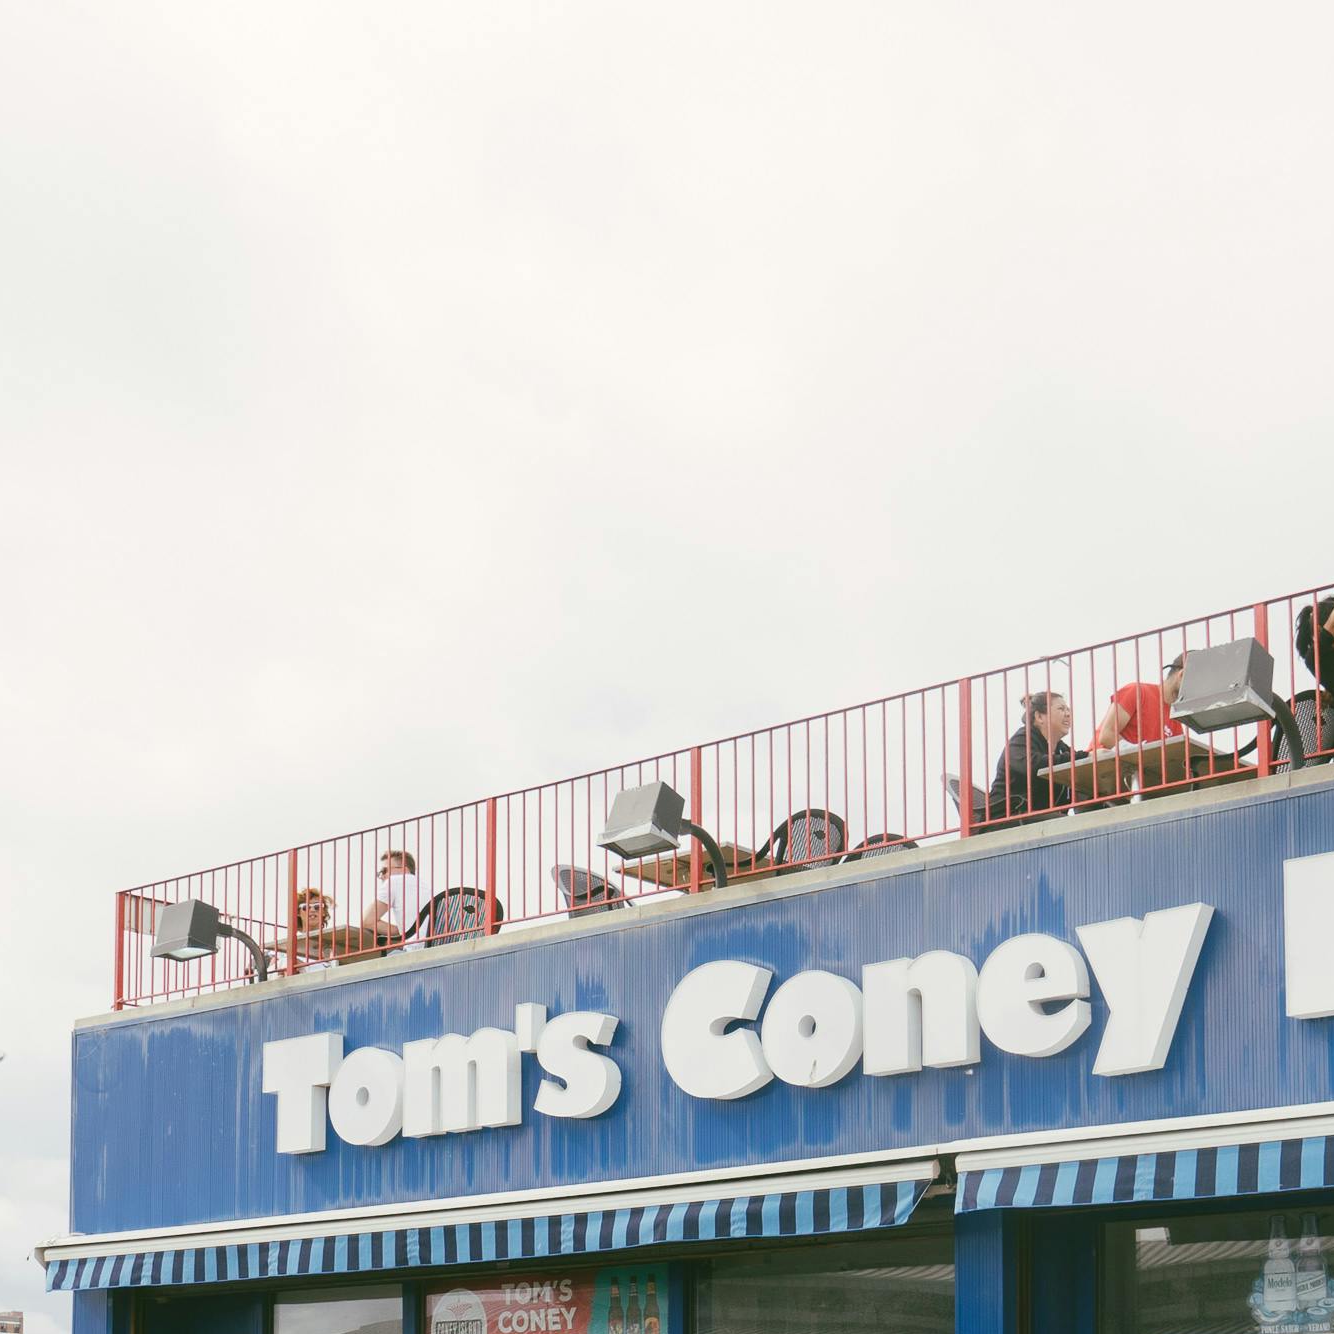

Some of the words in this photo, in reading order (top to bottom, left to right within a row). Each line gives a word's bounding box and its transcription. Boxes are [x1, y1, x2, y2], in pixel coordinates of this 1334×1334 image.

[264, 1002, 621, 1154] Tom's
[662, 901, 1216, 1100] Coney
[501, 1279, 572, 1305] TOM'S
[1267, 1276, 1292, 1289] Modelo
[497, 1306, 577, 1334] CONEY
